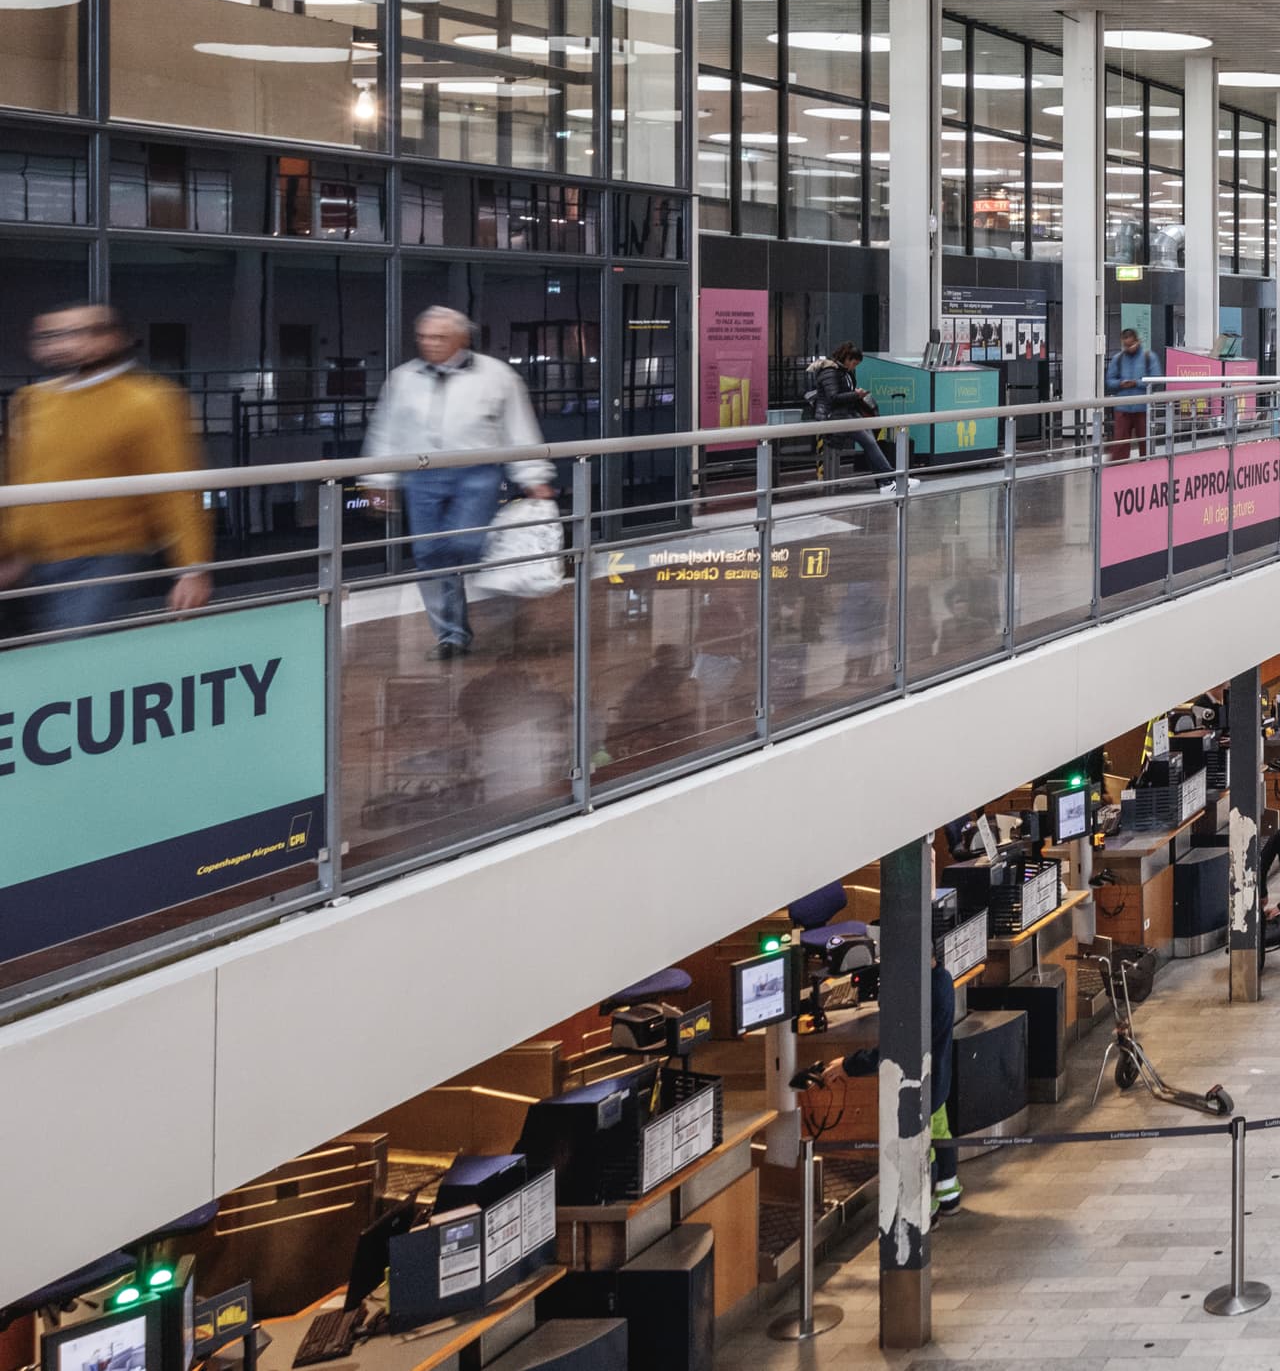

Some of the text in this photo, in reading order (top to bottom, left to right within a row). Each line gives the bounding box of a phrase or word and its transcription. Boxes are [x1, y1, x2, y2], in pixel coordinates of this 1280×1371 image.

[1113, 486, 1145, 517] YOU
[1149, 478, 1180, 509] ARE
[1184, 461, 1270, 502] APPROACHING
[1203, 506, 1213, 525] All
[289, 831, 306, 847] CPH
[196, 841, 286, 876] Copenhagen Airports
[1110, 1130, 1160, 1139] Lufthansa Group
